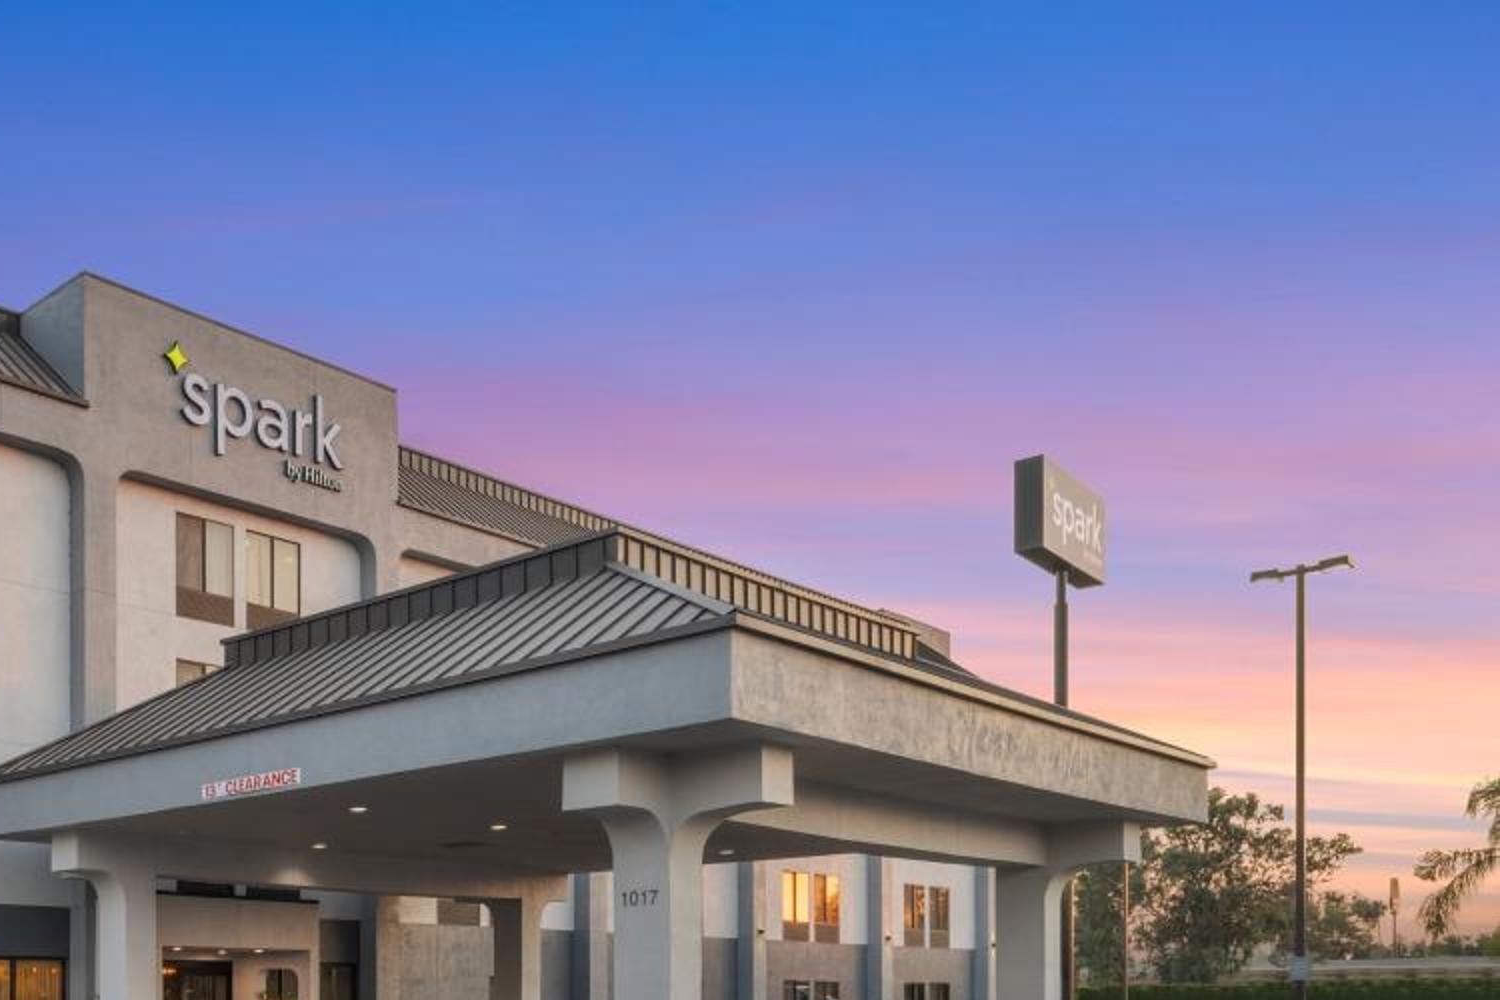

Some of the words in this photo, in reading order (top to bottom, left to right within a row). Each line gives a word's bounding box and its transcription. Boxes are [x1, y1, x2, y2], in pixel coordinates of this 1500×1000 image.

[182, 373, 342, 470] spark
[285, 459, 302, 483] by
[1052, 491, 1102, 553] spark
[226, 768, 297, 795] CLEARANCE
[621, 889, 660, 907] 1017
